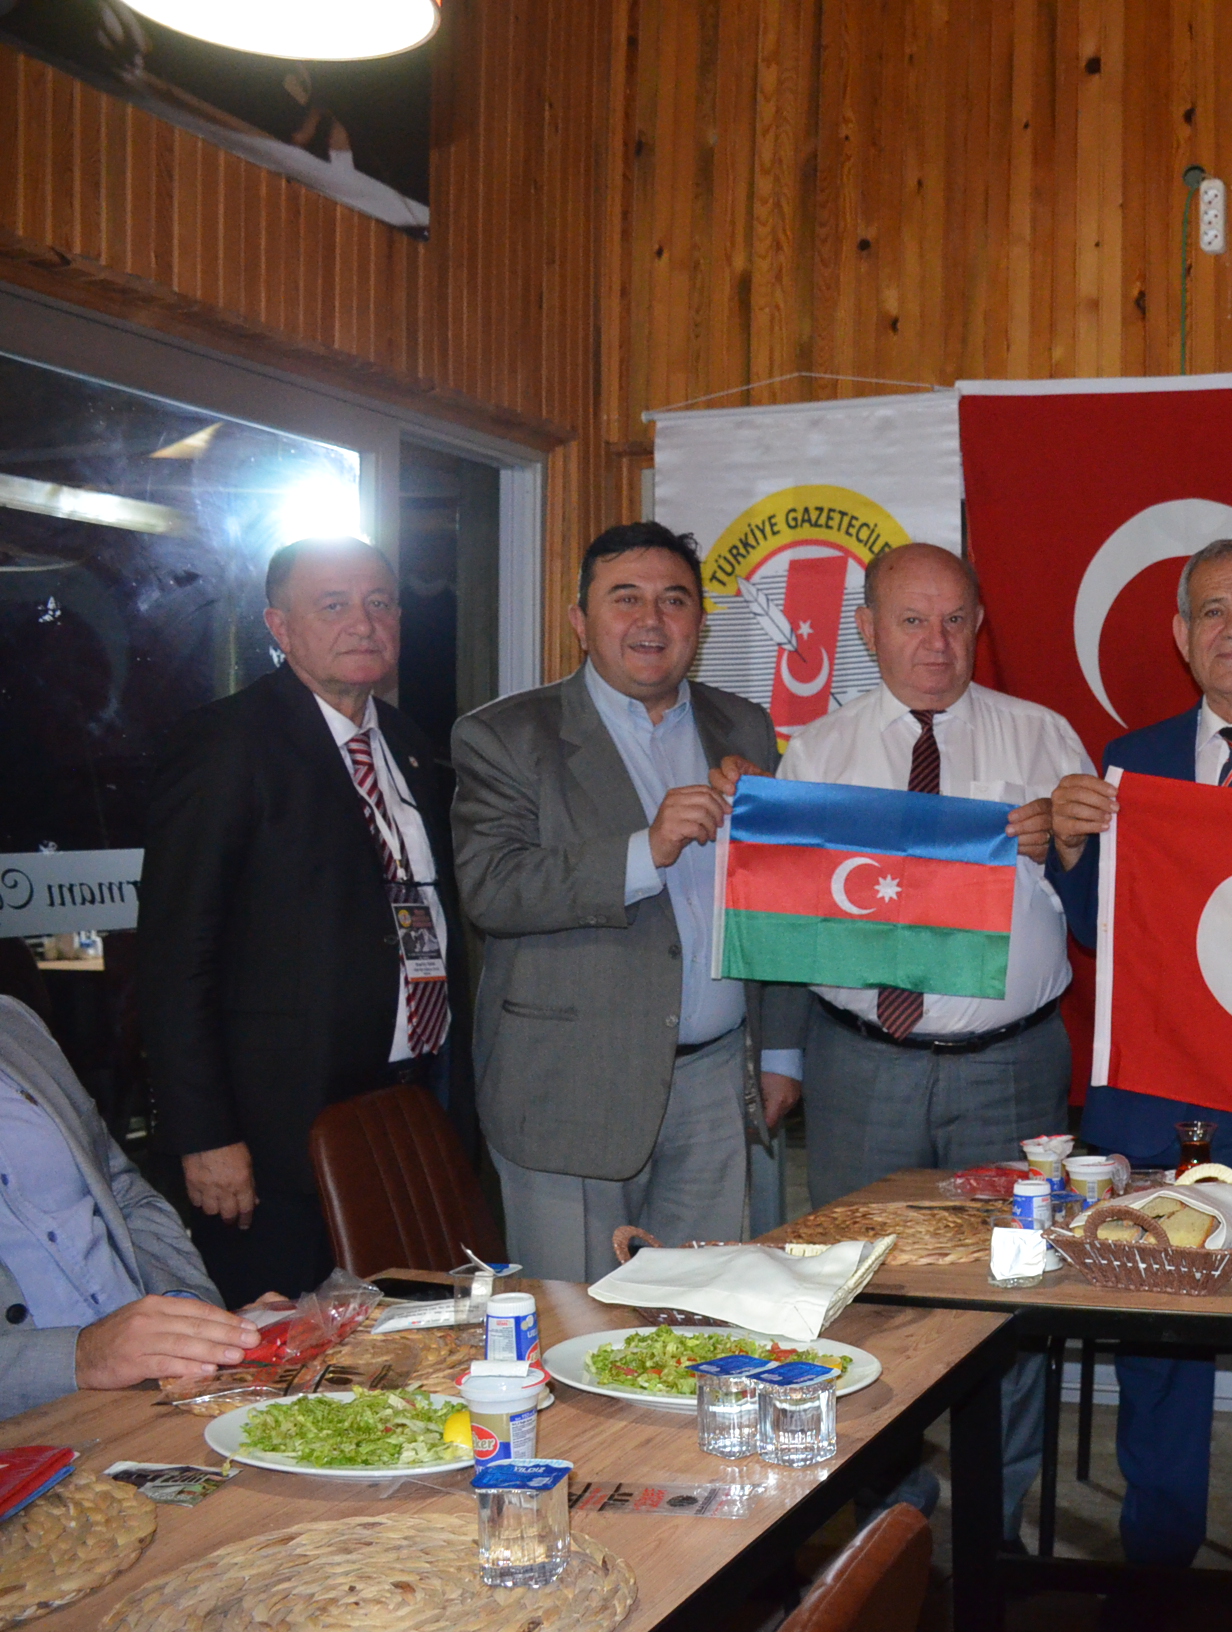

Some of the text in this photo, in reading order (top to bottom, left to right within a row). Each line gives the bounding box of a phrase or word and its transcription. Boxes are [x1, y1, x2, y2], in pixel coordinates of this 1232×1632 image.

[709, 505, 893, 588] TÜRKİYE GAZETECİLE
[472, 1436, 494, 1450] ker
